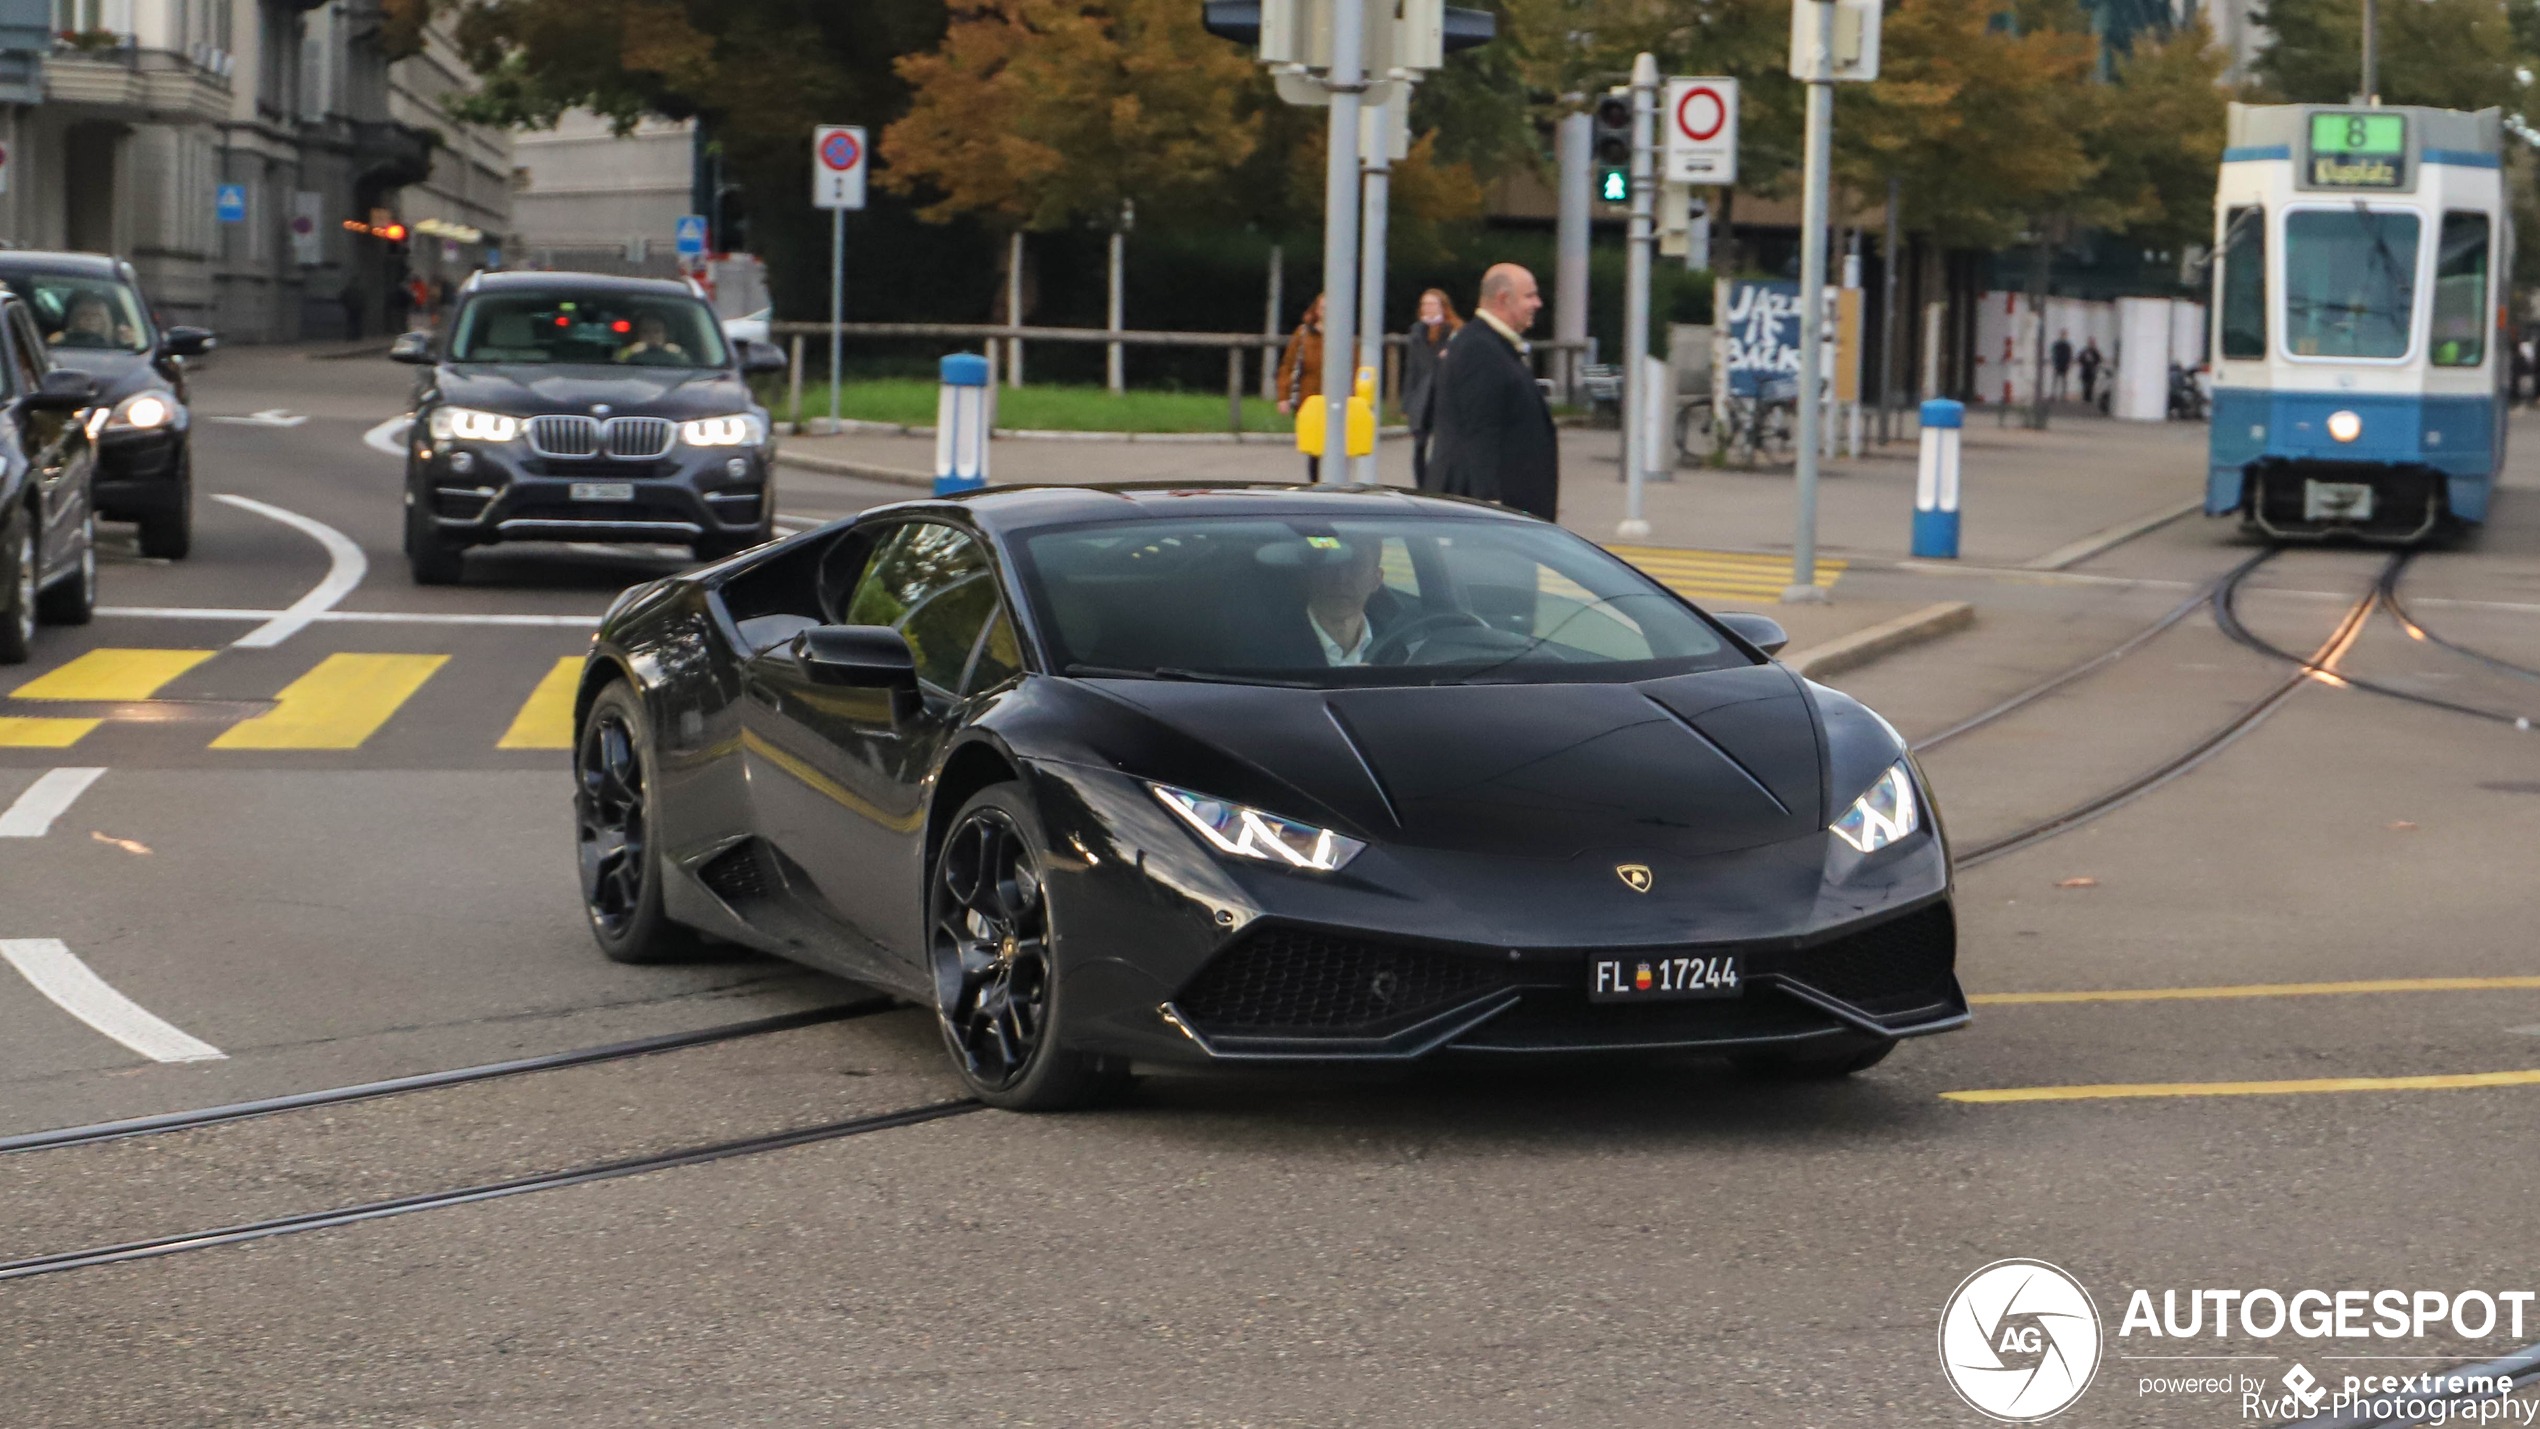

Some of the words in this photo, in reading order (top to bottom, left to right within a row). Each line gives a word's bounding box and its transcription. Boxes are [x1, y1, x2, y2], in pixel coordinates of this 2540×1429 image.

[2346, 116, 2366, 148] 8
[1597, 961, 1630, 992] FL
[1659, 957, 1739, 991] 17244
